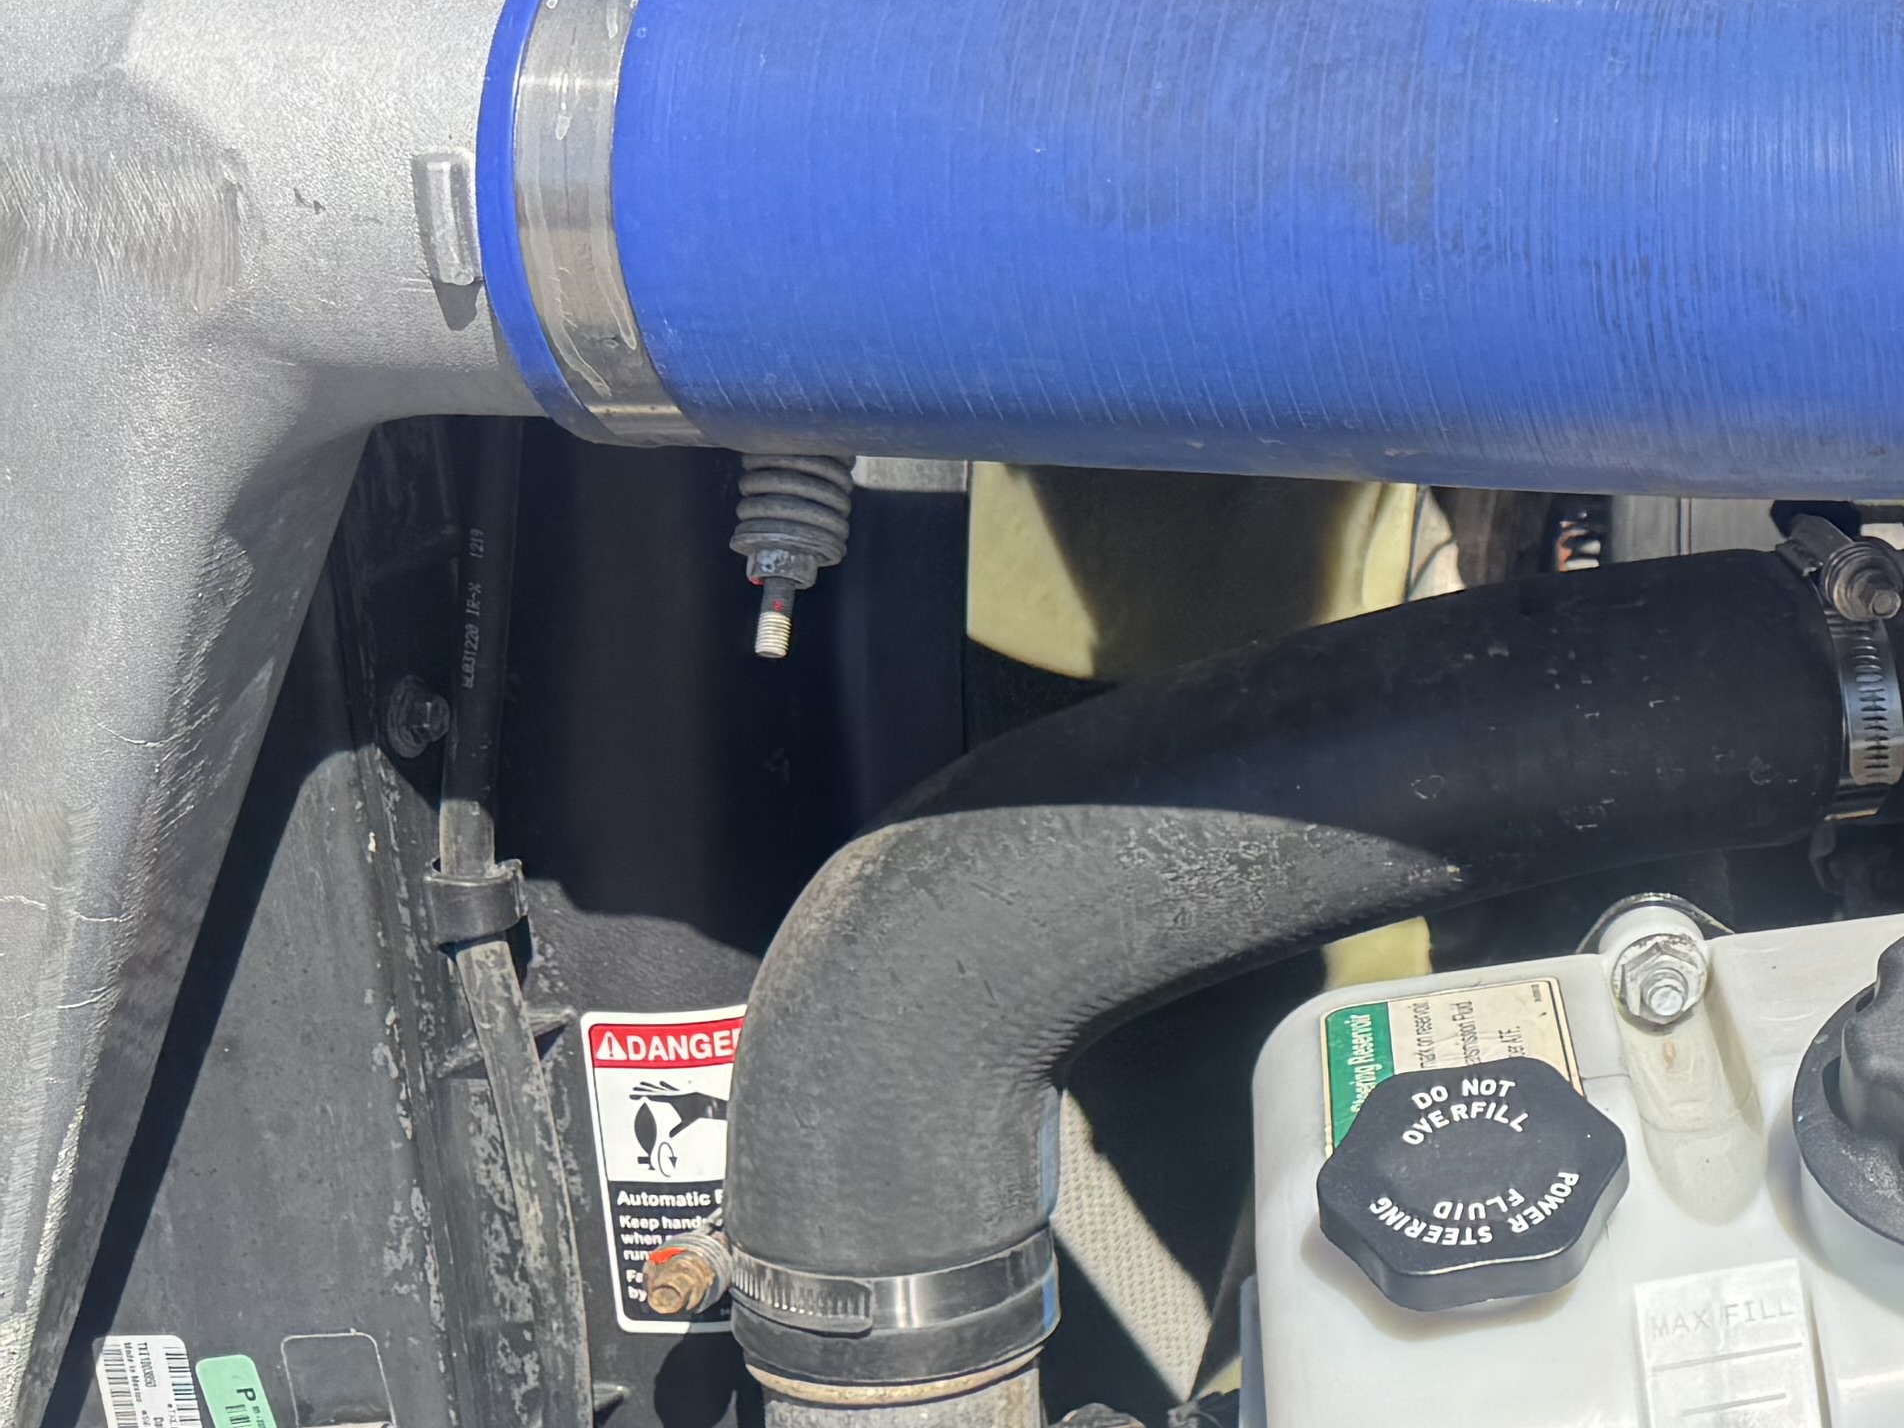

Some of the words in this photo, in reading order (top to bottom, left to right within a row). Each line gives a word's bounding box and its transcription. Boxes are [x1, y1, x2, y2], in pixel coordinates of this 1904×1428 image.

[1345, 1013, 1376, 1064] Reservoir
[1458, 1020, 1482, 1065] ansmission
[1412, 1086, 1448, 1110] DO
[1462, 1078, 1516, 1097] NOT
[1402, 1102, 1528, 1146] OVERFILL
[617, 1191, 710, 1206] Automatic
[1433, 1188, 1525, 1220] FLUID
[1508, 1172, 1580, 1233] POWER
[619, 1216, 659, 1231] Keep
[1369, 1197, 1492, 1245] STEERING
[621, 1234, 661, 1245] when
[1651, 1308, 1710, 1338] MAX
[1725, 1299, 1794, 1325] FILL
[236, 1387, 257, 1402] P
